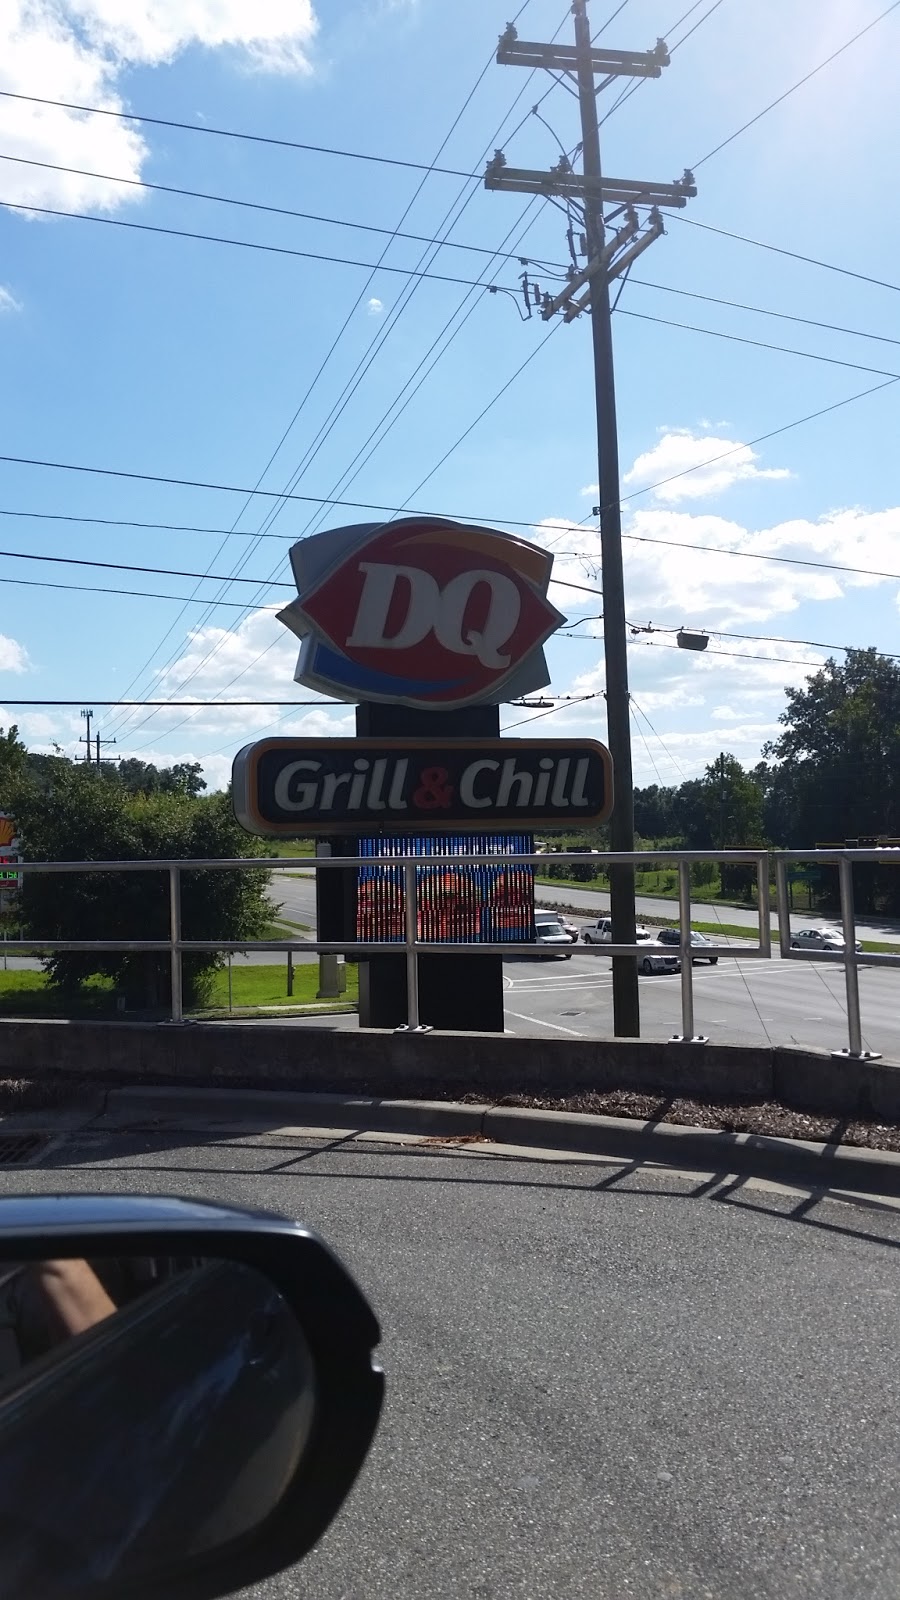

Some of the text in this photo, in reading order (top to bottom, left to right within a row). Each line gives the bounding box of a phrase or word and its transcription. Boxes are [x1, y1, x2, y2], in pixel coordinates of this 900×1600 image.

[346, 562, 521, 669] DQ
[274, 757, 590, 812] Grill & Chill
